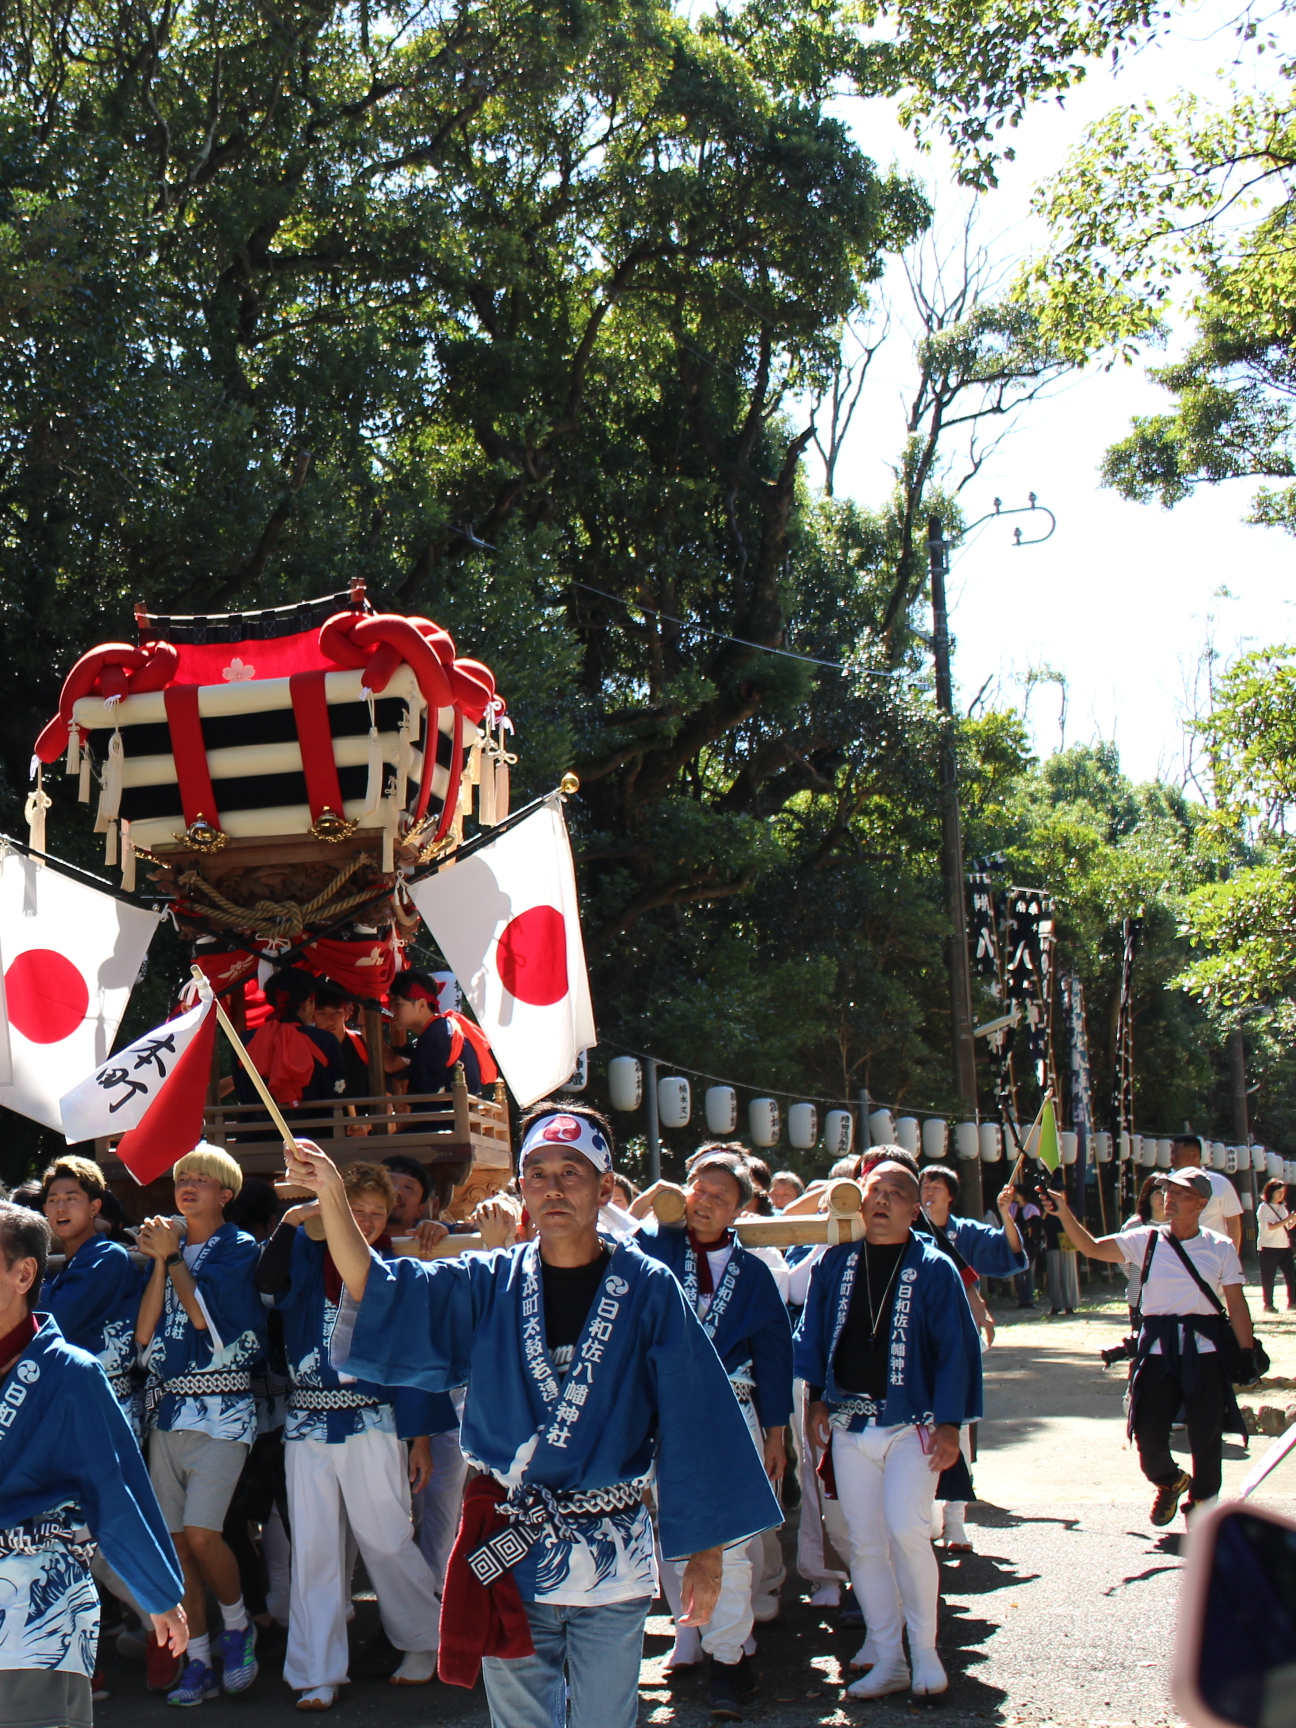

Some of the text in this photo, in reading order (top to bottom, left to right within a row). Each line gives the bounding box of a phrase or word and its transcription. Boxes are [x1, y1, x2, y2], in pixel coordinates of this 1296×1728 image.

[95, 1033, 176, 1113] 本町
[522, 1275, 559, 1412] 本町太鼓若連
[545, 1297, 620, 1449] 日和佐八幡神社
[889, 1284, 913, 1386] 日和佐八幡神社
